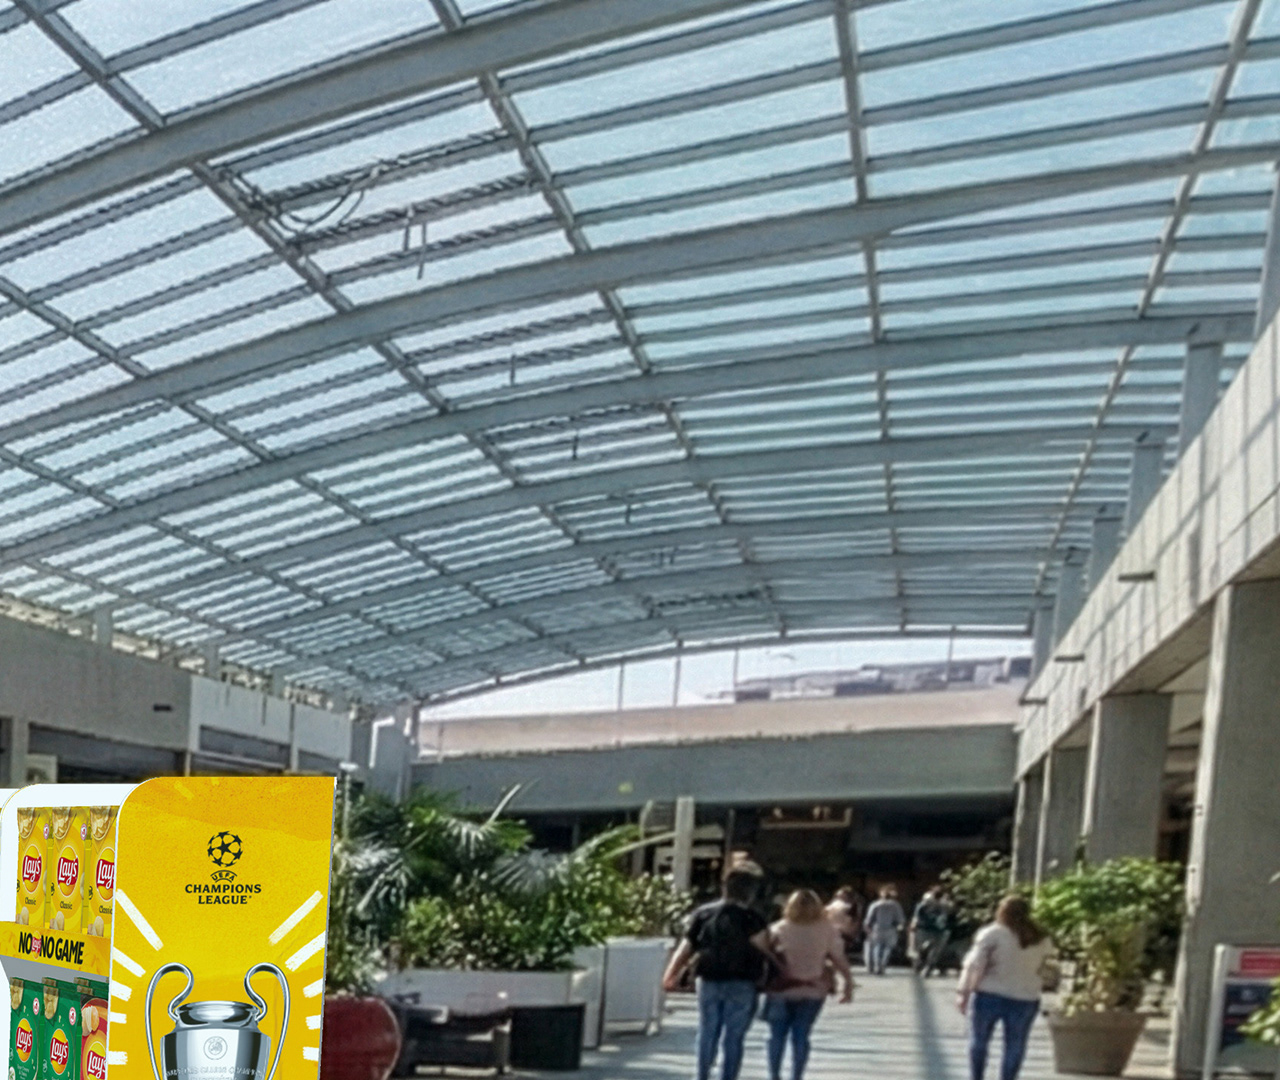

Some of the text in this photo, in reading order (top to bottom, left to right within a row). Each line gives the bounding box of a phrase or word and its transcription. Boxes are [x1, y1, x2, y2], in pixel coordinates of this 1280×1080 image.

[211, 872, 237, 882] UEFA
[185, 884, 262, 894] CHAMPIONS
[198, 895, 248, 905] LEAGUE
[18, 932, 32, 954] NO
[40, 935, 55, 960] NO
[55, 938, 85, 964] GAME
